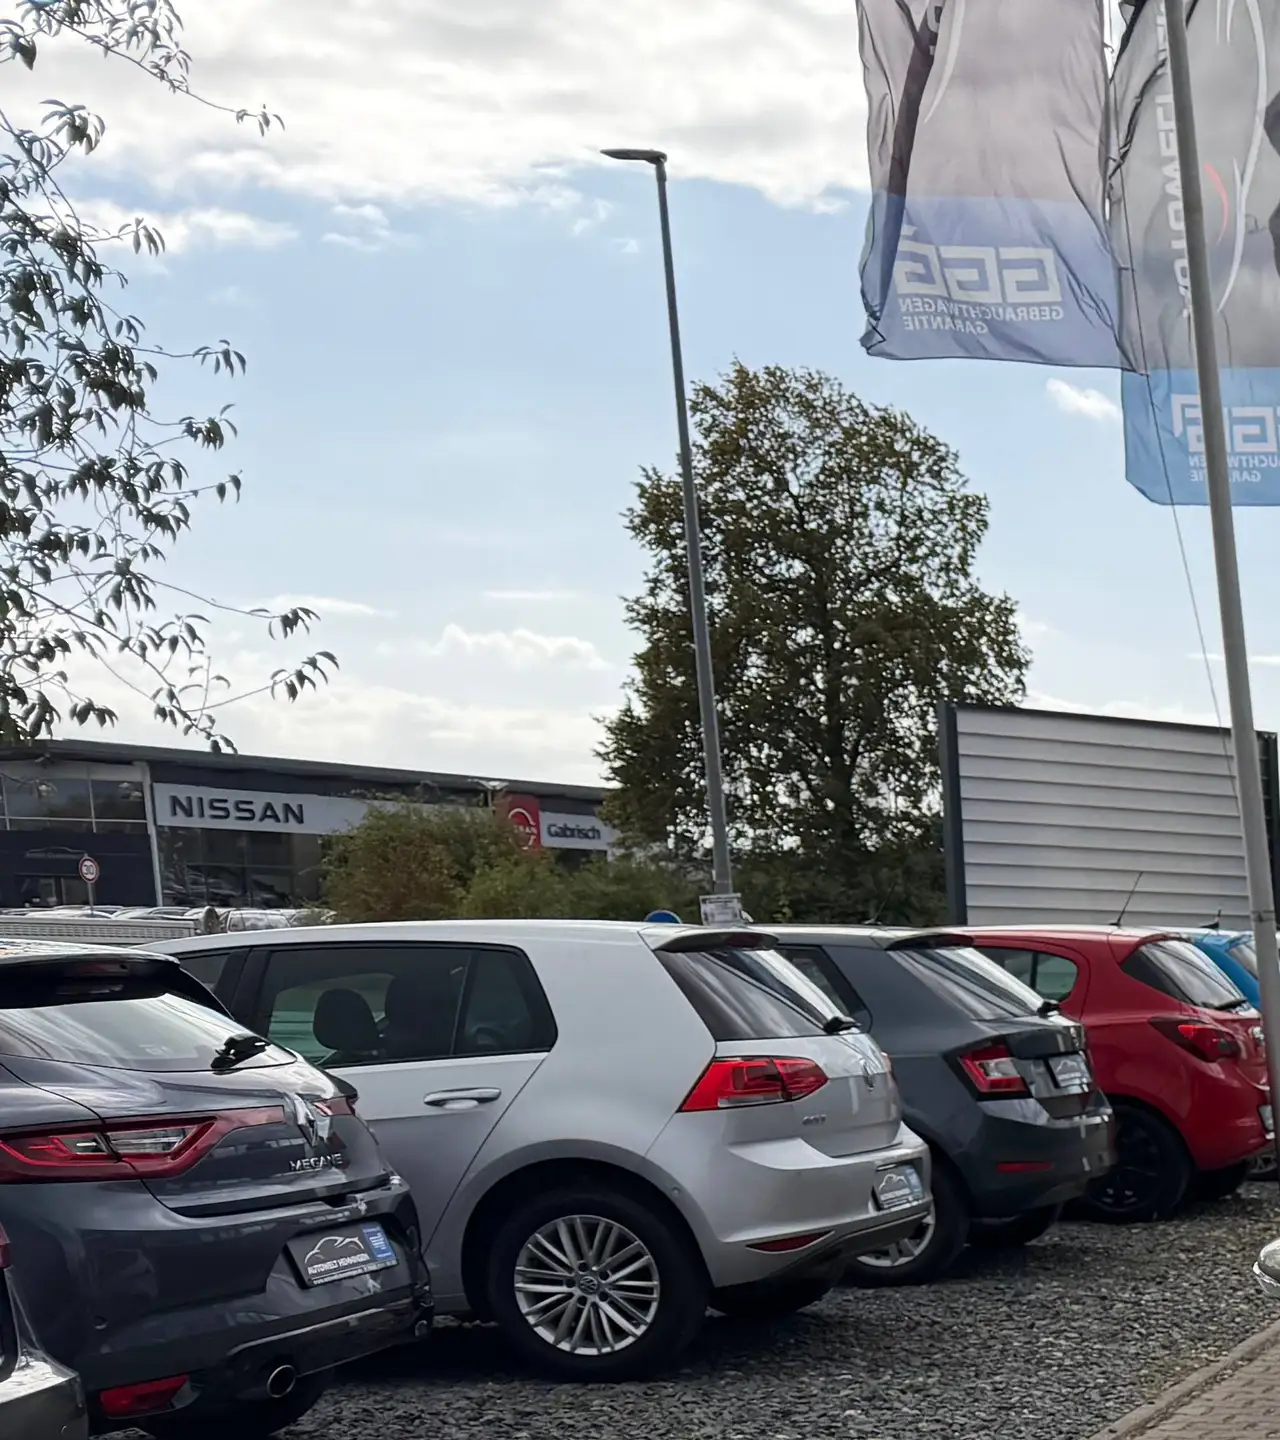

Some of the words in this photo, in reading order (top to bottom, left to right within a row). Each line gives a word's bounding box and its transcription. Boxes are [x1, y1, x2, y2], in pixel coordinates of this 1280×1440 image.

[169, 794, 304, 825] NISSAN
[547, 821, 601, 841] Gabrisch
[289, 1153, 343, 1171] MEGANE
